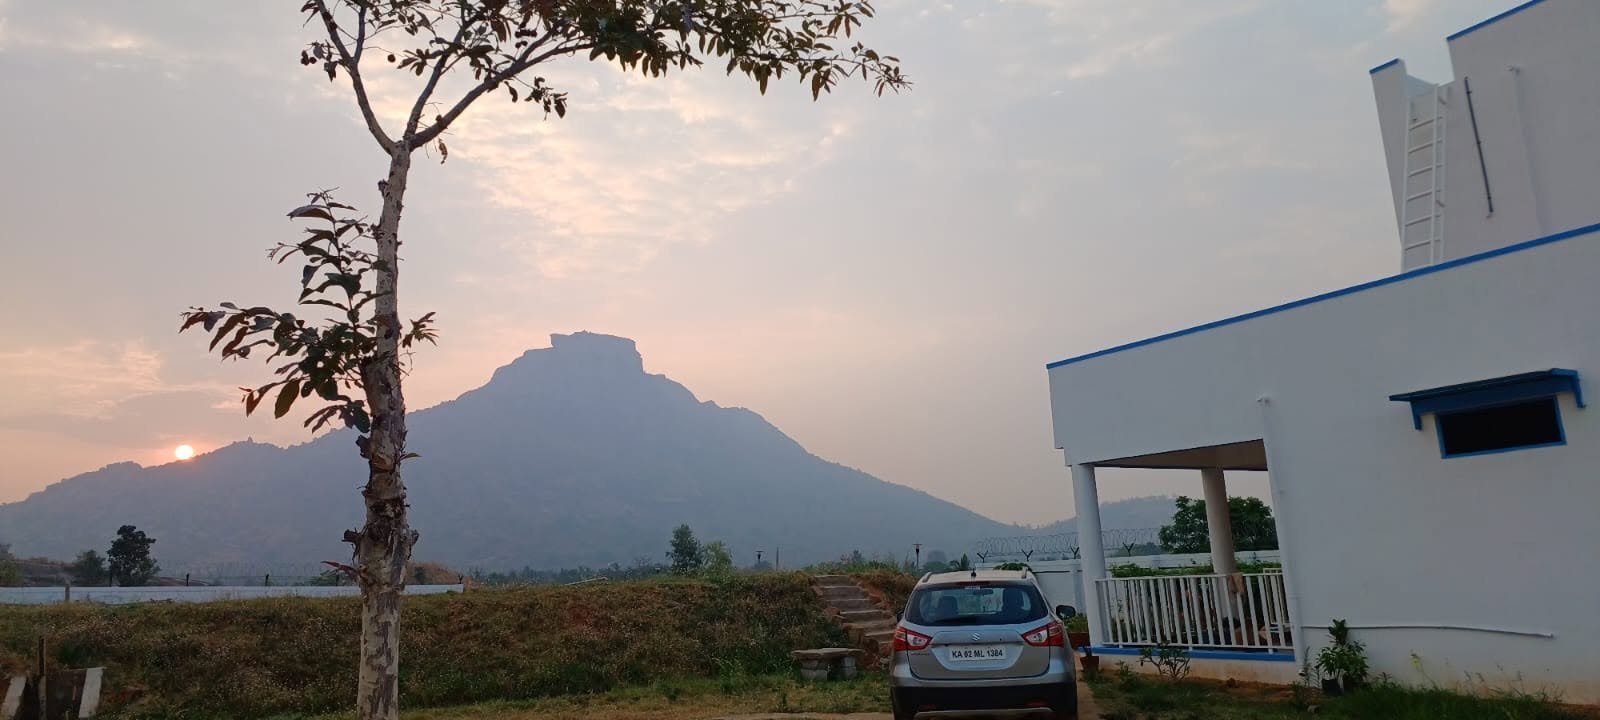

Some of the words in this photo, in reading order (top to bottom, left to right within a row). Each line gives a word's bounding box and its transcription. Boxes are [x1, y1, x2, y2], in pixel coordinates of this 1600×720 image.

[952, 650, 963, 658] KA
[964, 650, 973, 658] 02
[974, 649, 985, 658] ML
